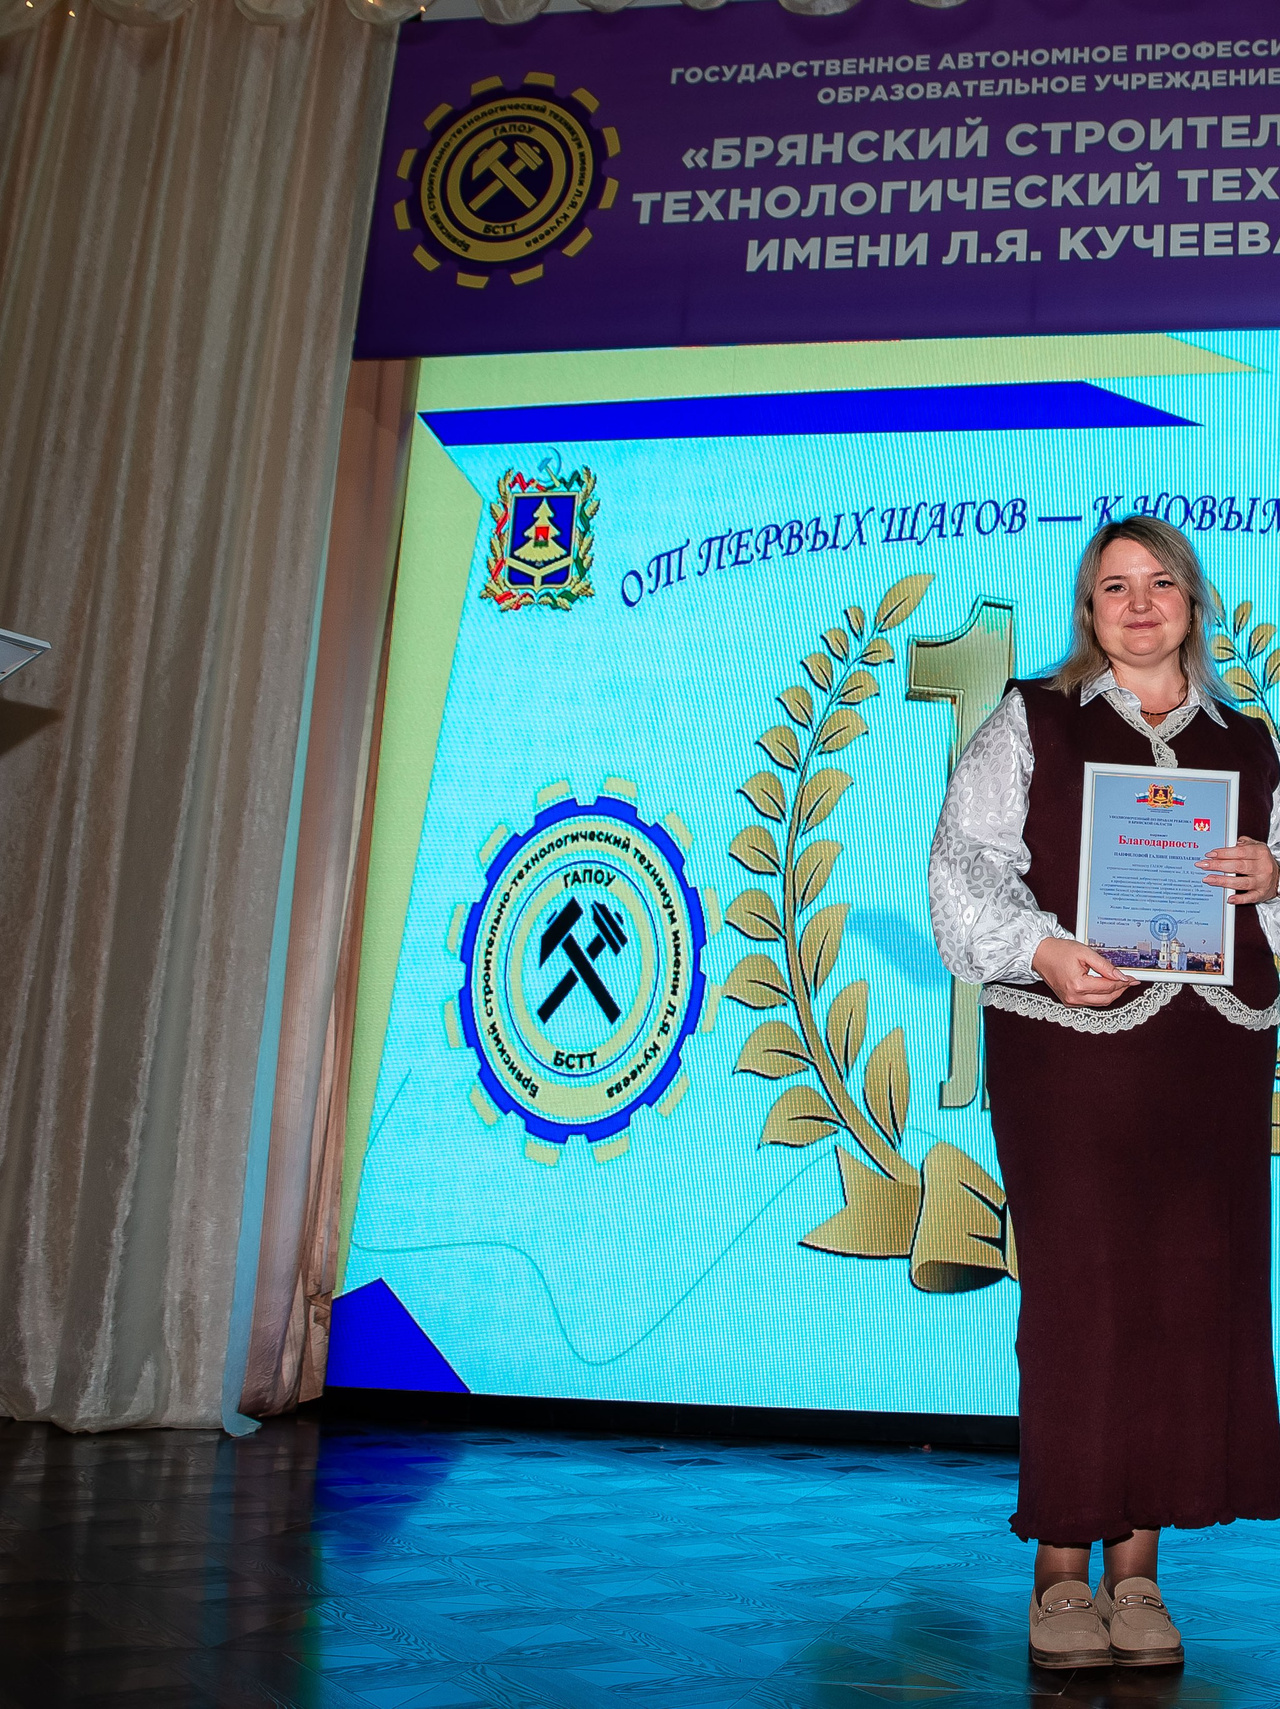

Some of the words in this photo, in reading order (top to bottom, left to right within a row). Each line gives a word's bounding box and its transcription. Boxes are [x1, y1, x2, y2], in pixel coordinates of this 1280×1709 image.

[670, 54, 931, 84] ГОСУДАРСТВЕННОЕ
[938, 45, 1128, 71] АВТОНОМНОЕ
[817, 76, 1086, 104] ОБРАЗОВАТЕЛЬНОЕ
[492, 123, 536, 136] ГАПОУ
[682, 117, 989, 169] «БРЯНСКИЙ
[632, 162, 1160, 224] ТЕХНОЛОГИЧЕСКИЙ
[483, 222, 518, 234] БСТТ
[746, 232, 928, 272] ИМЕНИ
[942, 229, 1042, 265] Л.Я.
[620, 538, 690, 608] ОТ
[696, 505, 876, 577] ПЕРВЫХ
[879, 497, 1027, 547] ШАГОВ
[1118, 834, 1199, 849] Благодарность
[562, 868, 617, 888] ГАПОУ
[632, 846, 677, 926] техникум
[670, 929, 682, 996] имени
[486, 1020, 540, 1098] Брянский
[552, 1050, 598, 1069] БСТТ
[606, 1041, 661, 1098] Кучеева
